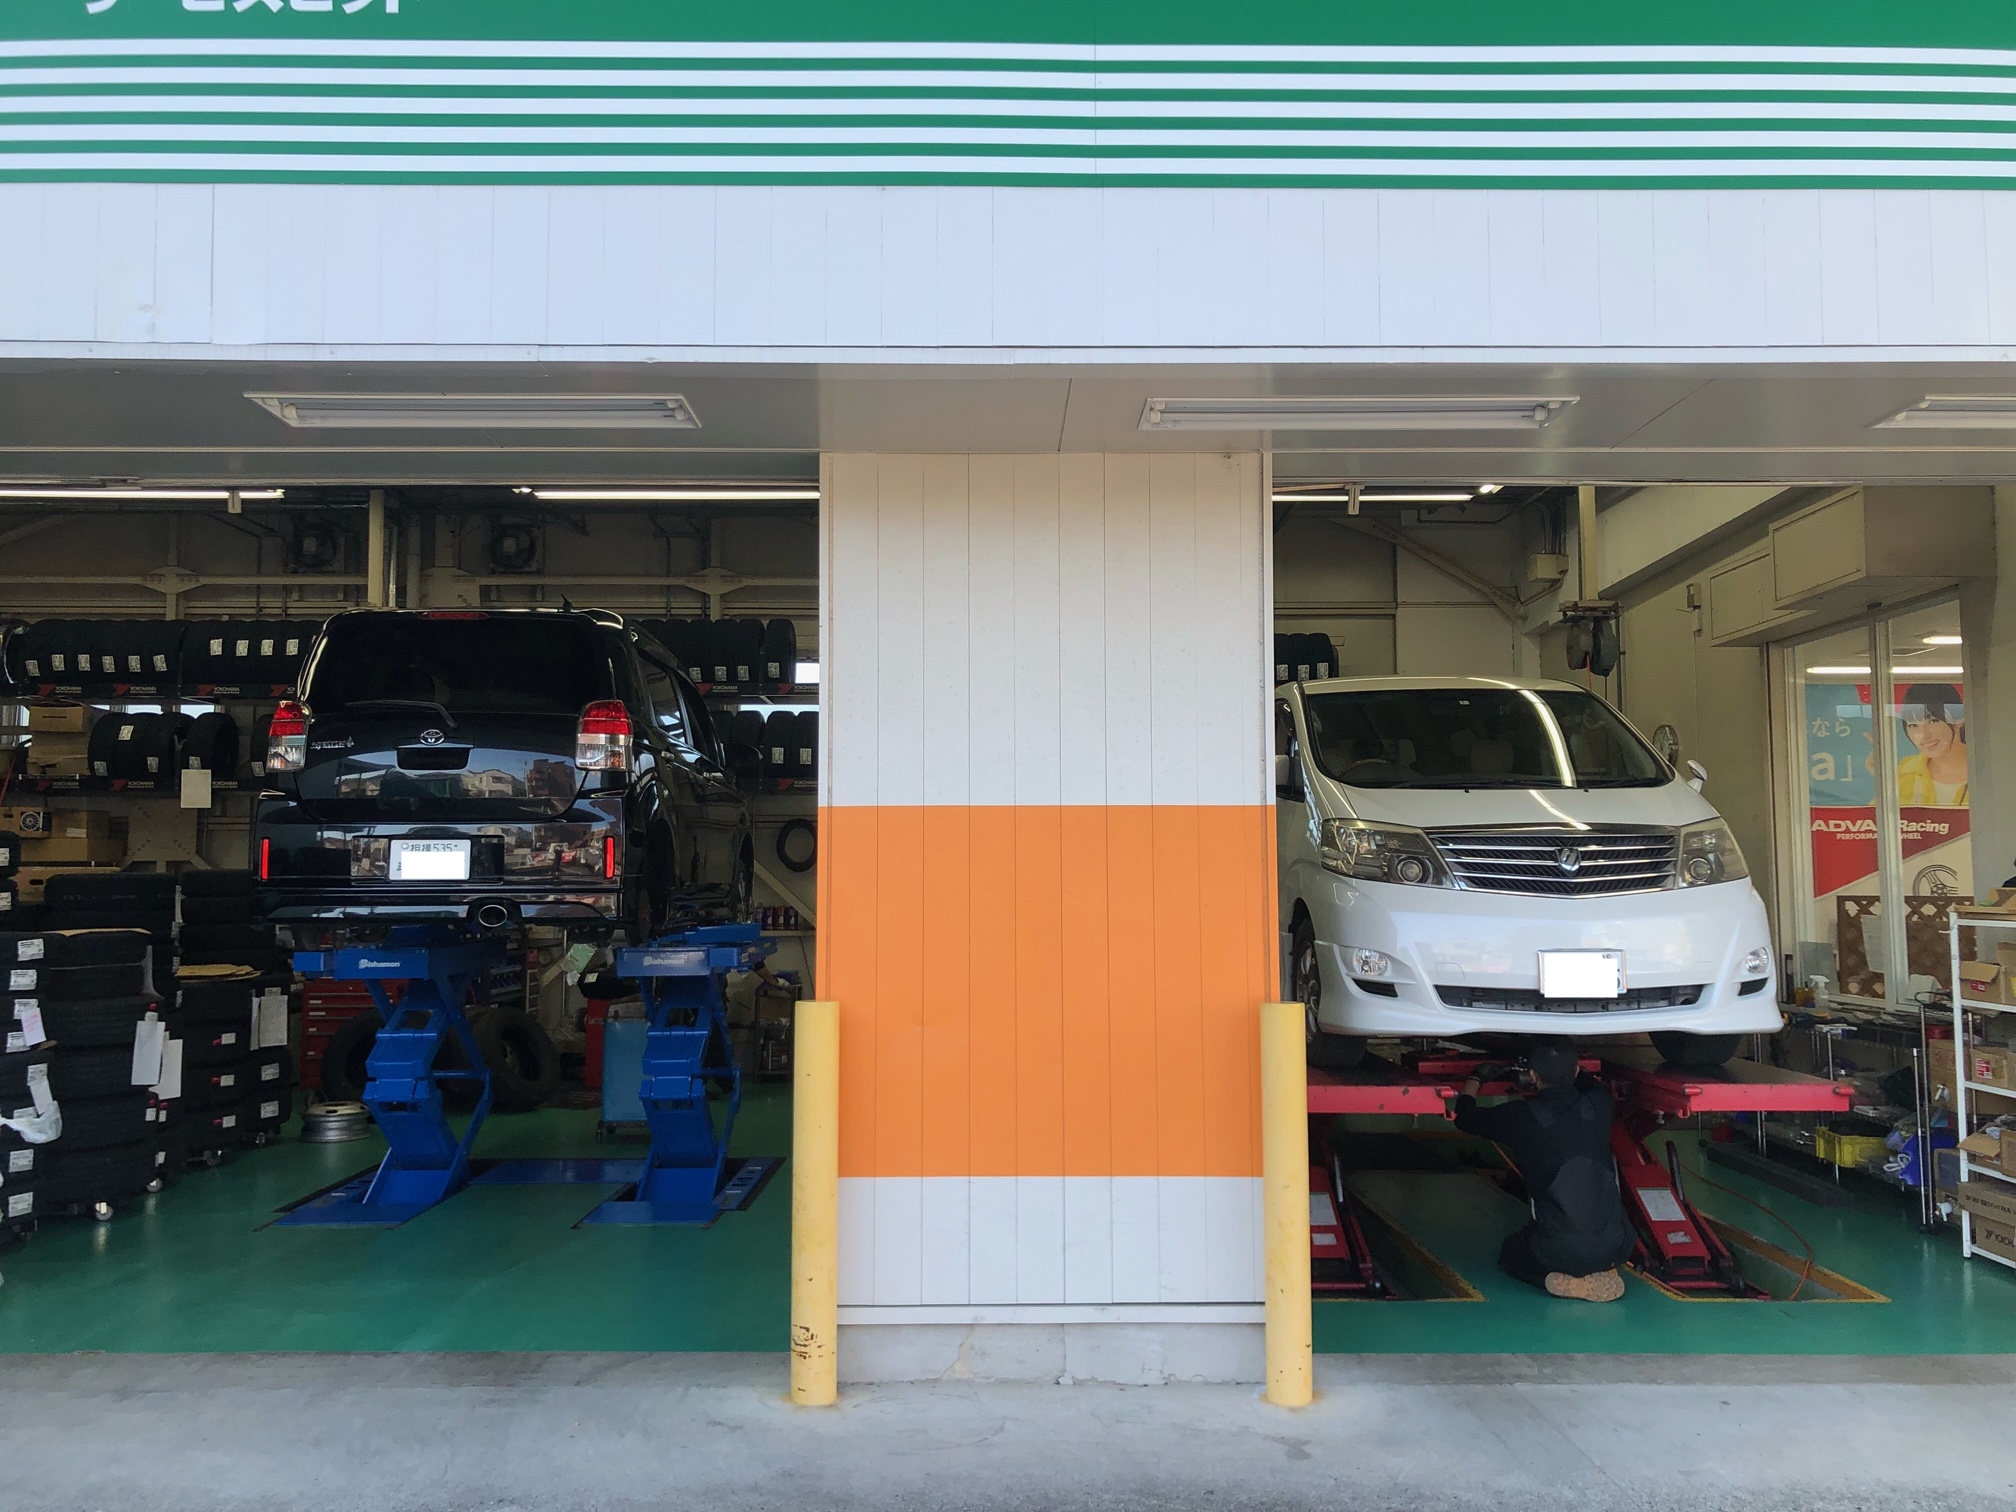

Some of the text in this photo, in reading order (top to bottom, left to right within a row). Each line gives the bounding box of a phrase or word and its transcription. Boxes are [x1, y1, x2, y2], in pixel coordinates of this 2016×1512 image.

[1807, 717, 1851, 737] なら
[1811, 819, 1878, 832] ADVA
[1836, 832, 1878, 840] PERFORMA
